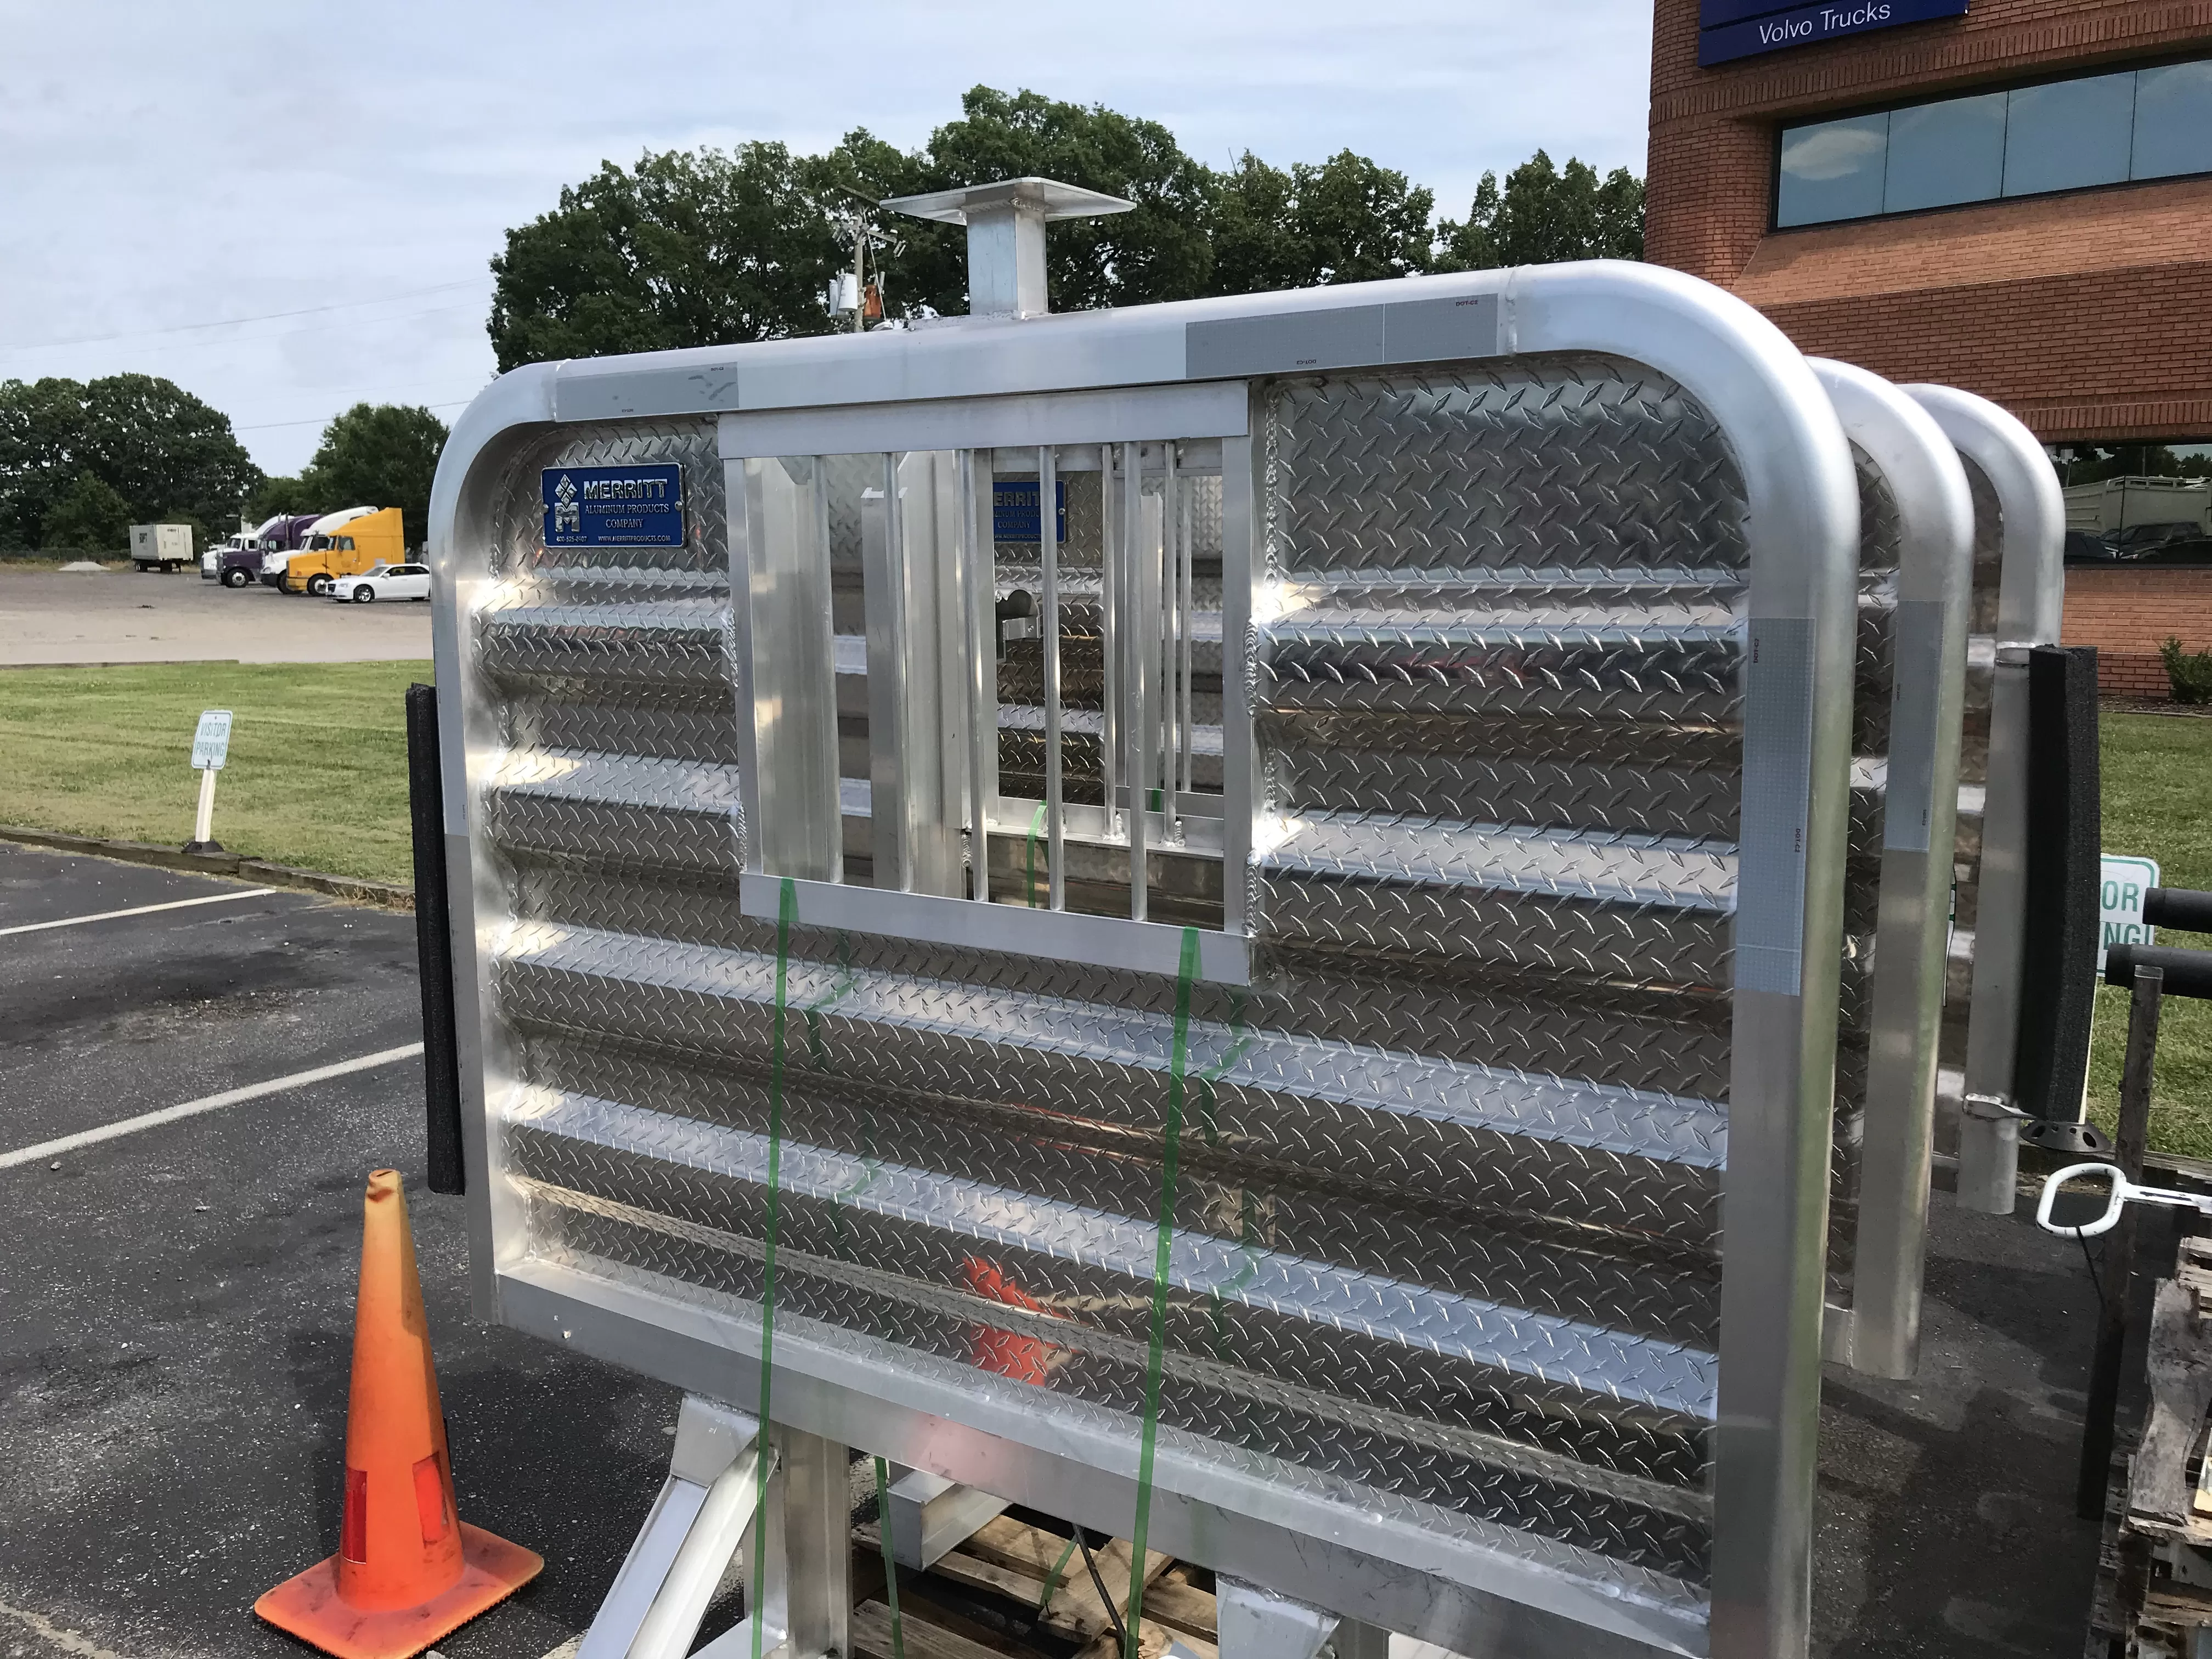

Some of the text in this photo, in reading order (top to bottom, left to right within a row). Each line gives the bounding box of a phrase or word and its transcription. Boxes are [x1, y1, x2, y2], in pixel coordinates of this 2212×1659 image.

[1759, 2, 1891, 44] Volvo Trucks
[583, 478, 668, 500] MERRITT
[994, 491, 1040, 506] ERRIT
[585, 504, 669, 514] ALUMINUM PRODUCTS
[606, 518, 644, 528] COMPANY
[200, 723, 227, 737] VISITOR
[195, 742, 224, 757] PARKING
